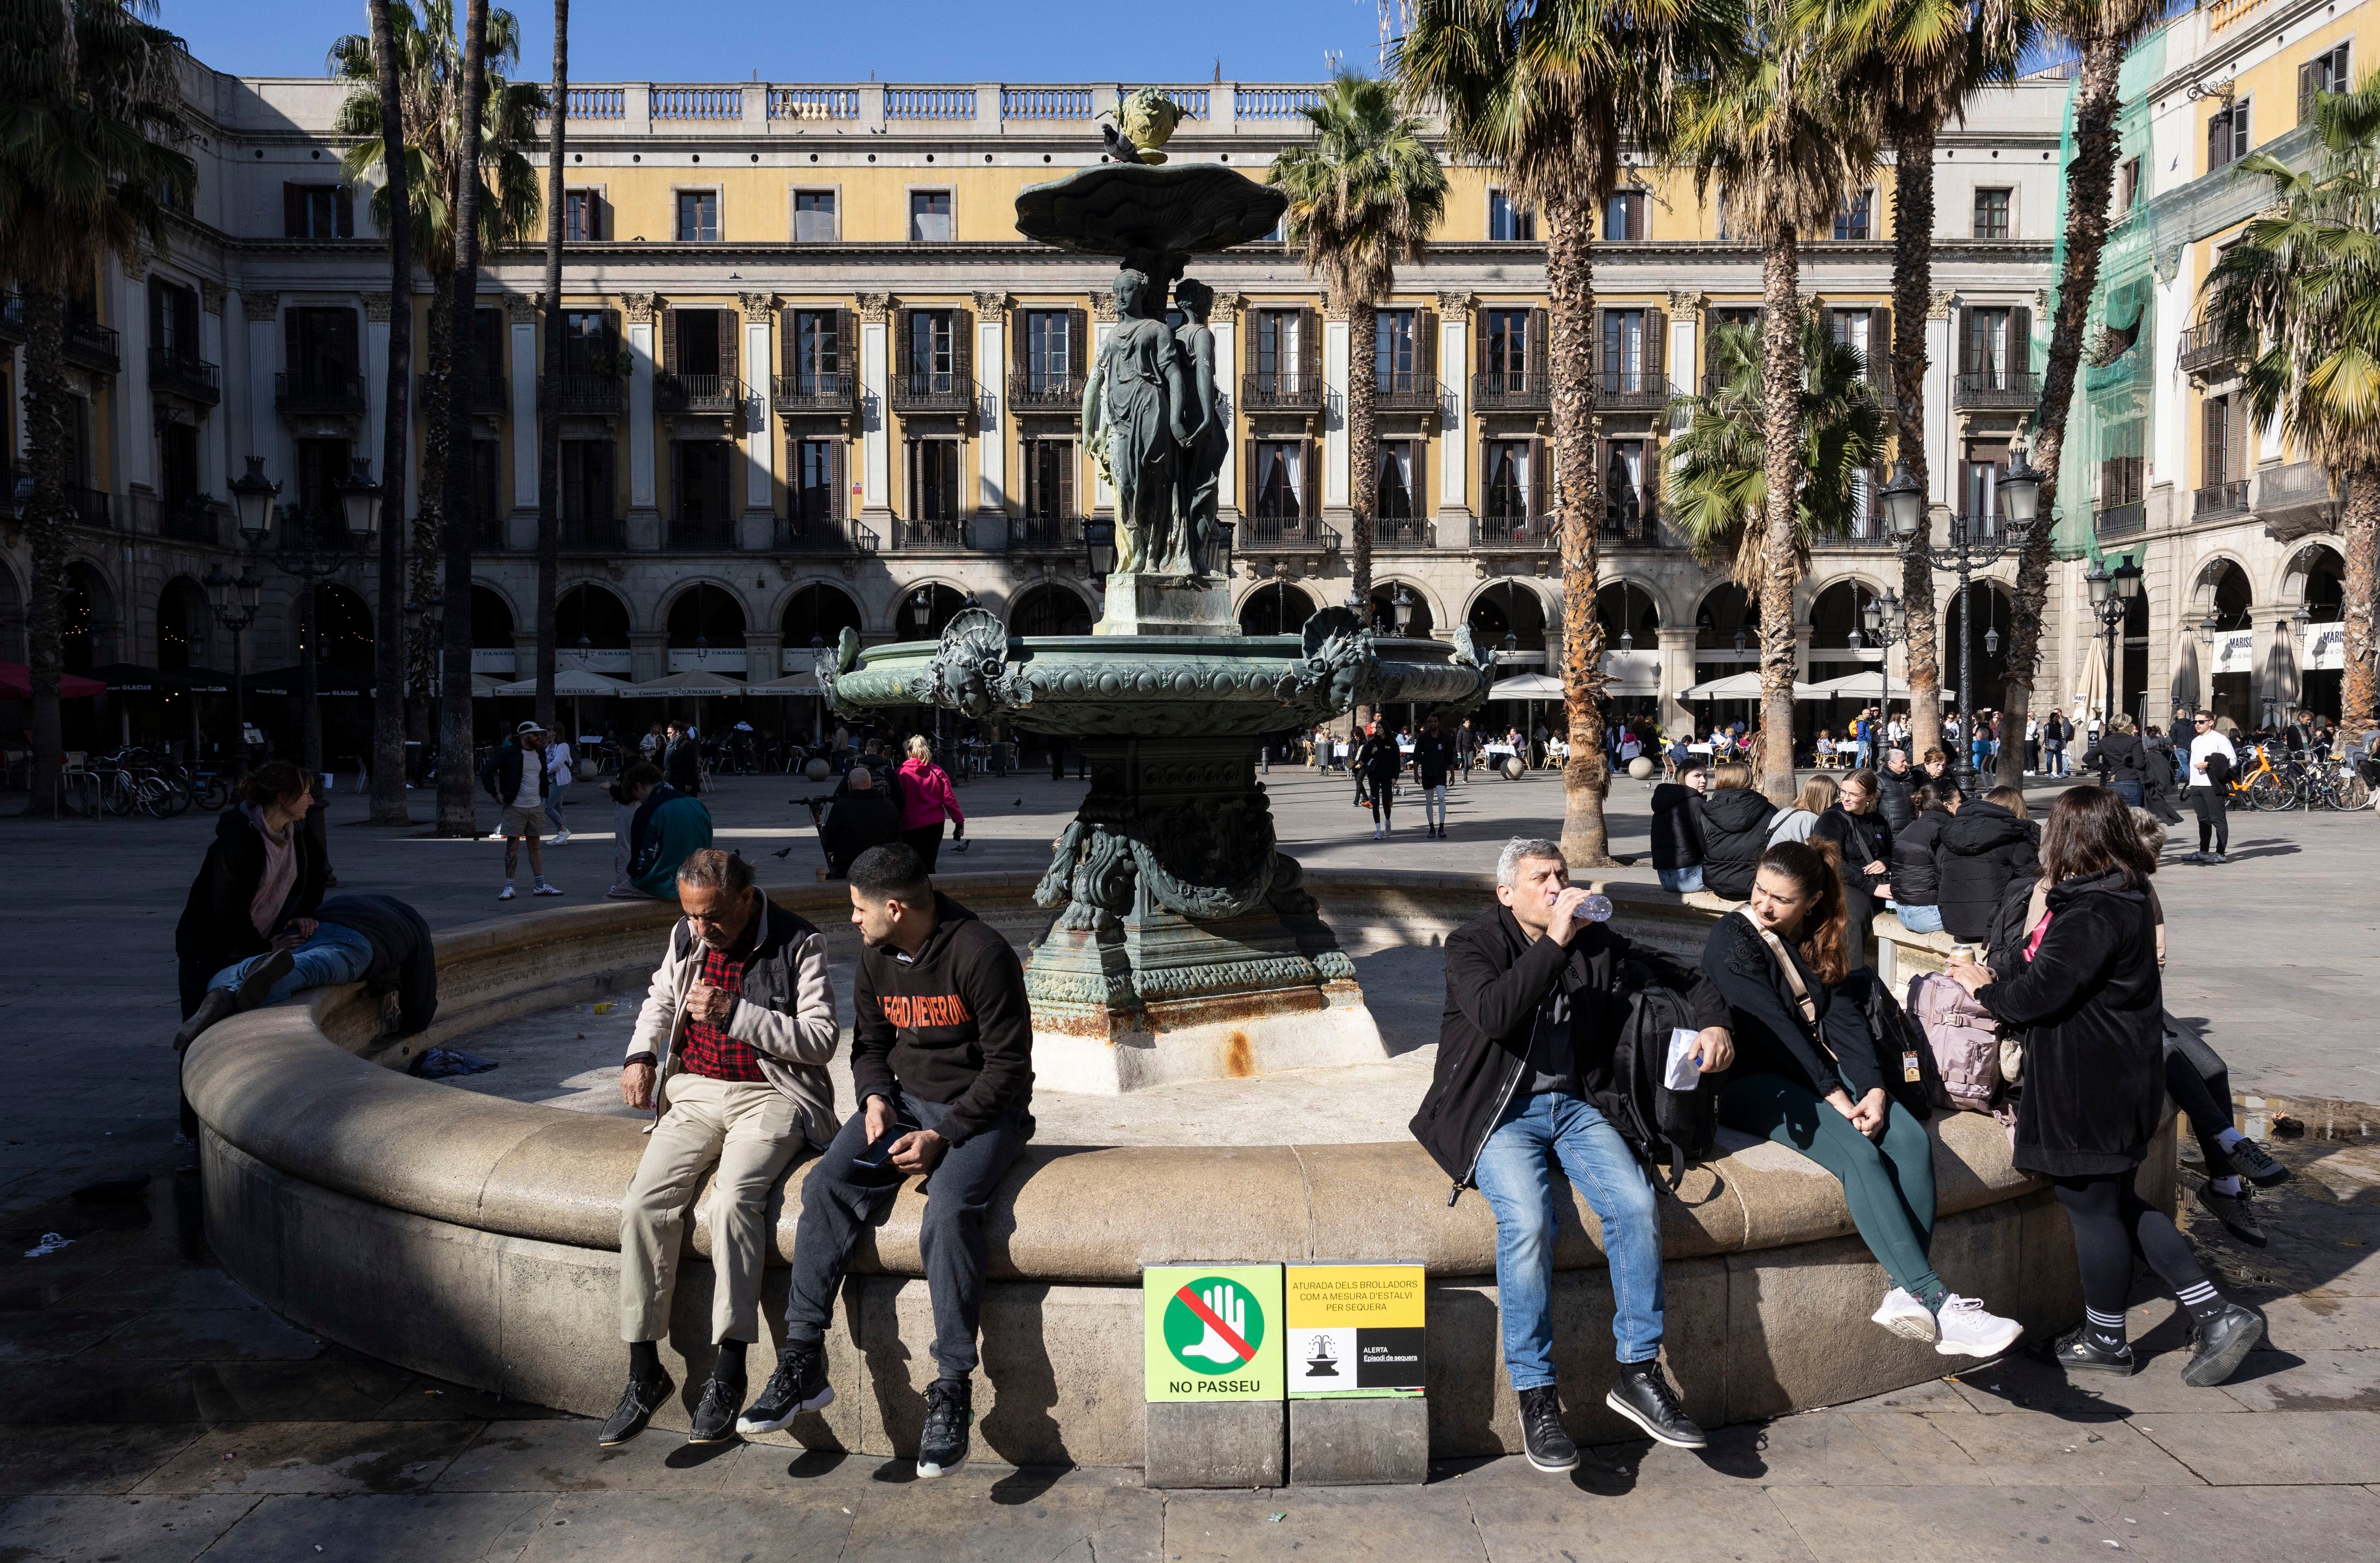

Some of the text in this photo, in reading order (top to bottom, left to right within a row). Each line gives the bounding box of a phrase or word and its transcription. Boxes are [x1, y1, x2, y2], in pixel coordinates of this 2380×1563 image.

[912, 995, 952, 1027] NEVER
[1360, 1281, 1418, 1289] BROLLADORS
[1169, 1380, 1260, 1393] NO PASSEU
